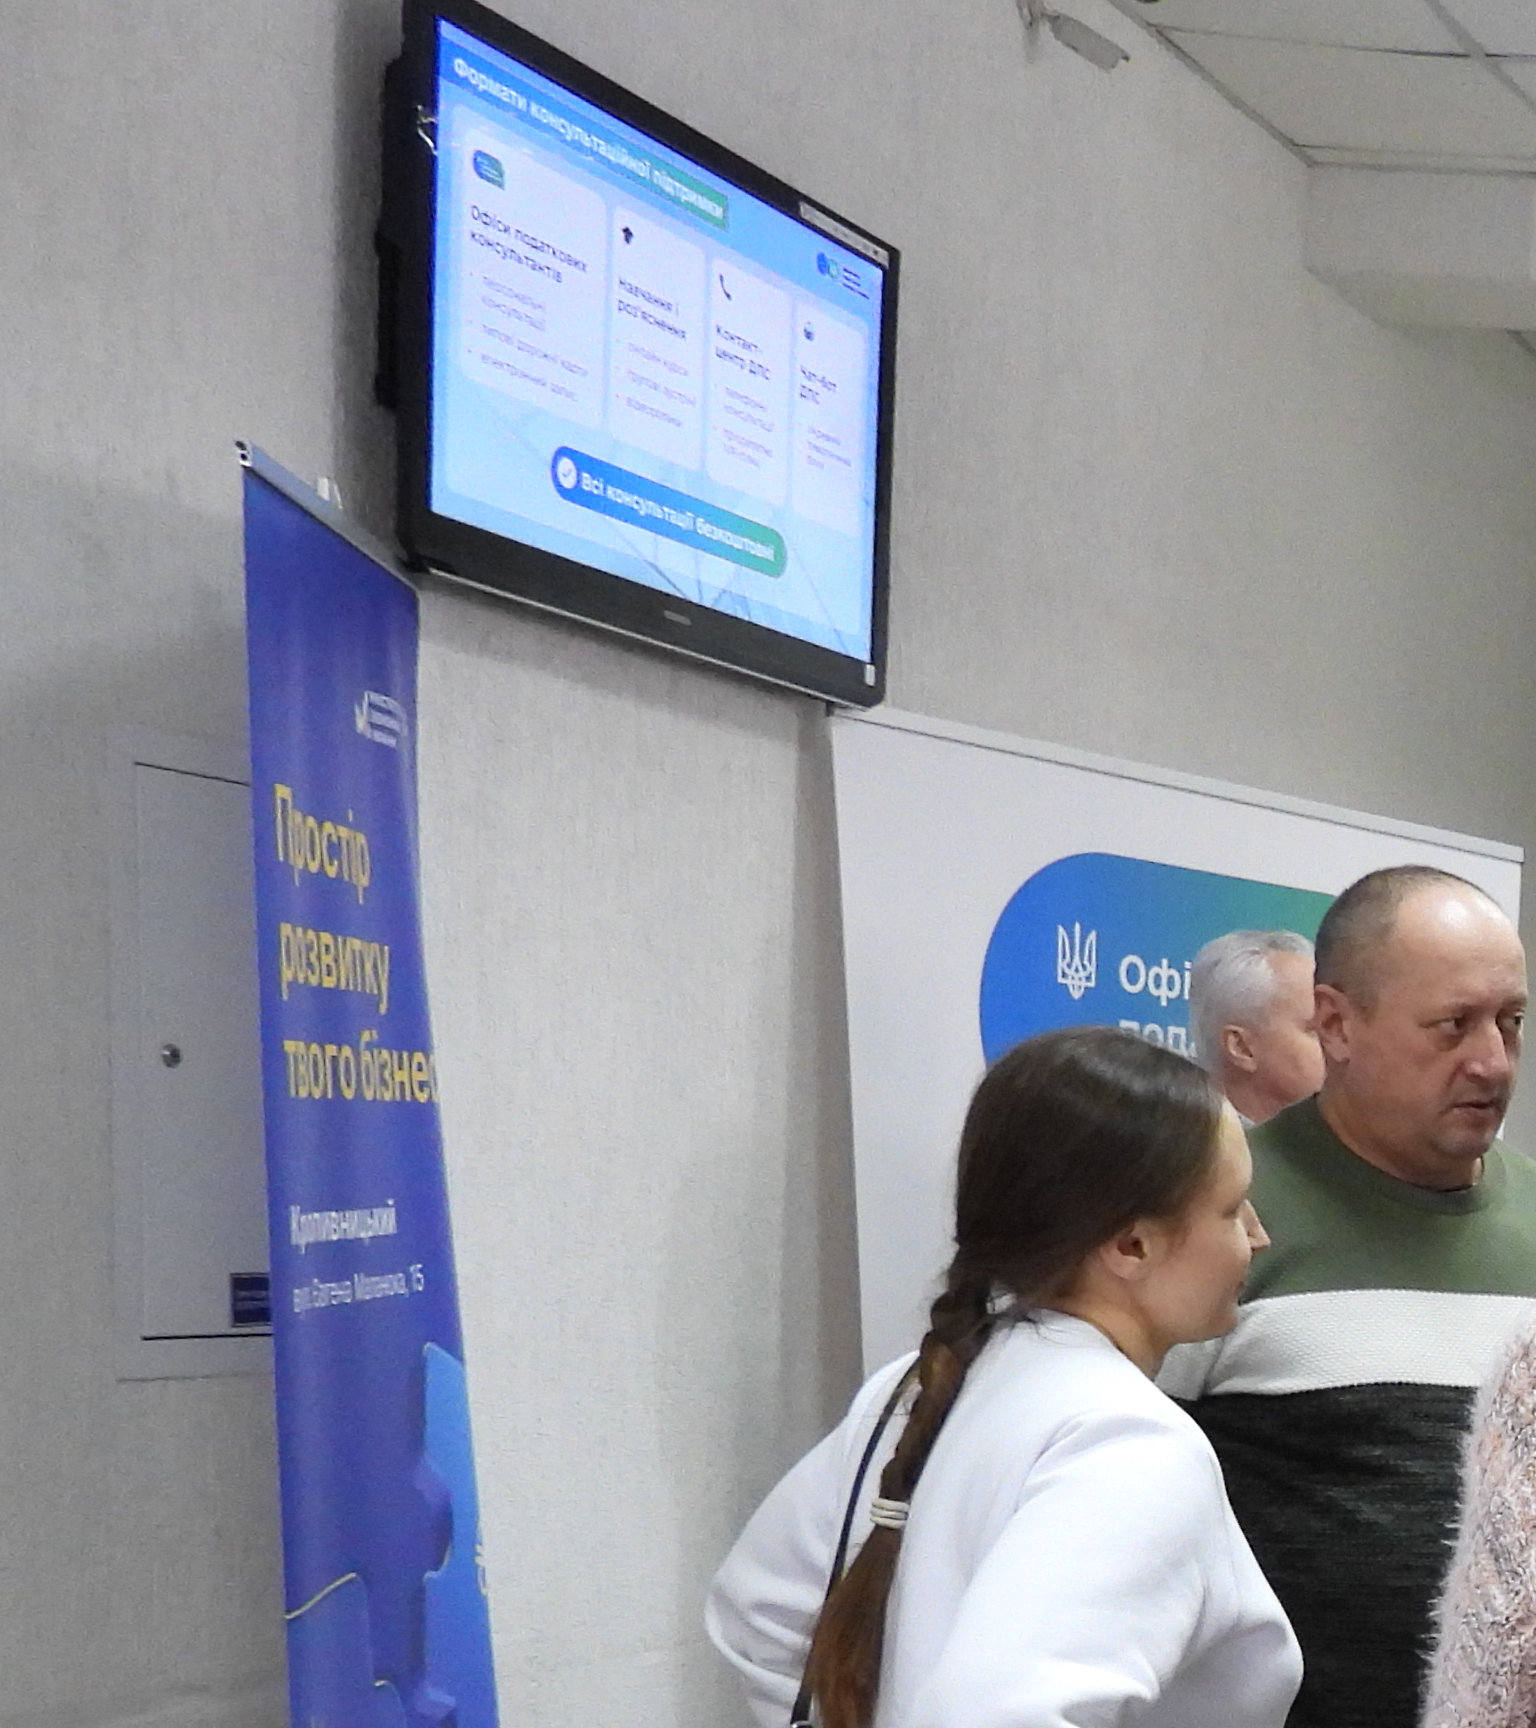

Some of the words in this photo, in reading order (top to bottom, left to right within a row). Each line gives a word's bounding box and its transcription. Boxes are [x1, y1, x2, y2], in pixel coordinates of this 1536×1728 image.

[454, 58, 527, 112] Формати
[581, 471, 606, 497] Всі
[606, 485, 695, 532] консультації
[274, 783, 371, 906] Простір
[279, 921, 390, 1015] розвитку
[1119, 954, 1193, 1006] Офі
[283, 1039, 355, 1099] твого
